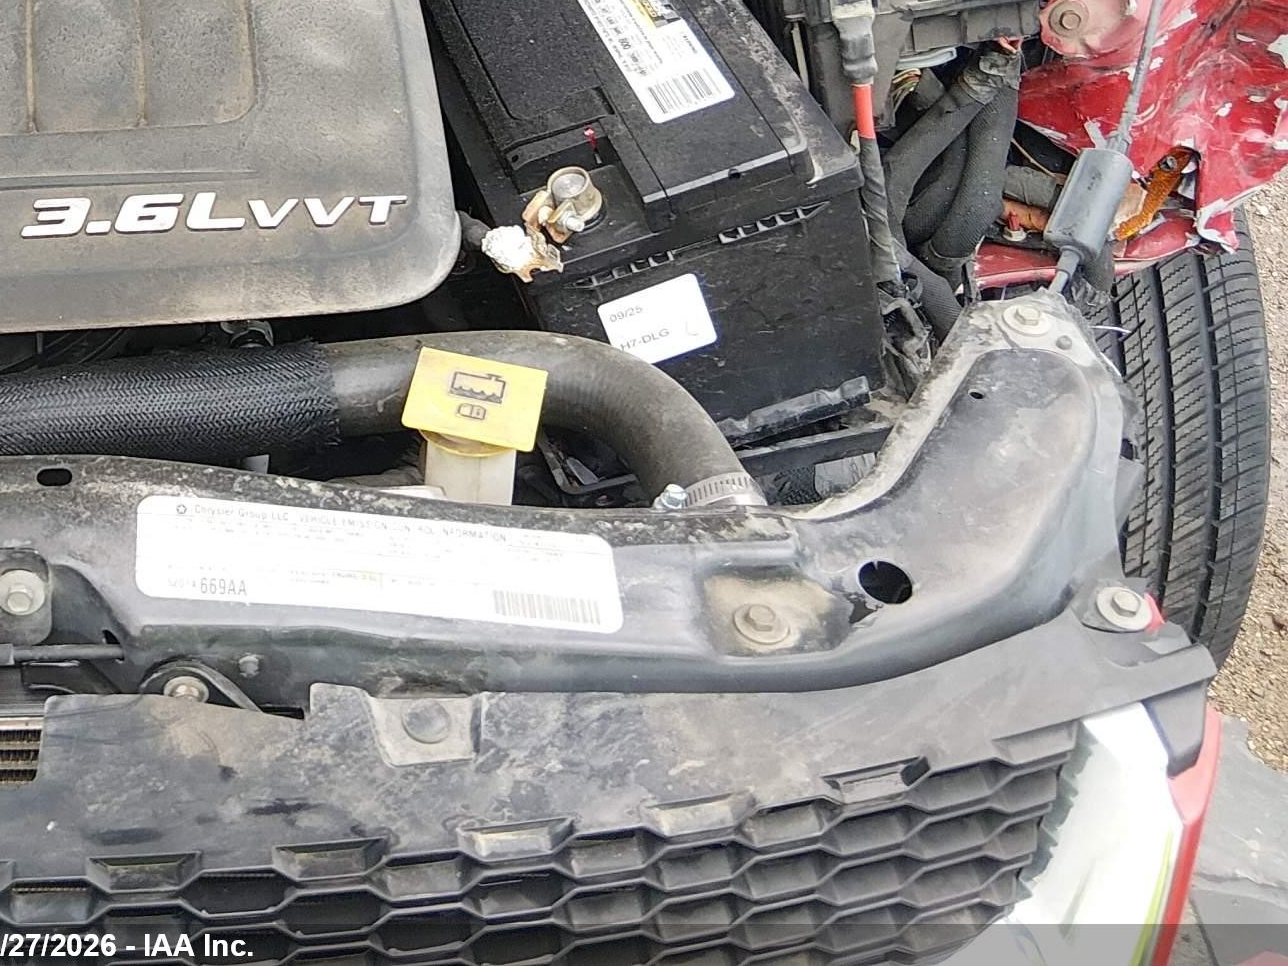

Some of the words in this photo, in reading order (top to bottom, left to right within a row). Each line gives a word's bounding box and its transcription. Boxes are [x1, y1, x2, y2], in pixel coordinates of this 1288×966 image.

[194, 504, 233, 517] Chrysler
[238, 508, 268, 521] Group
[272, 512, 289, 521] LLC
[200, 577, 248, 596] 669AA
